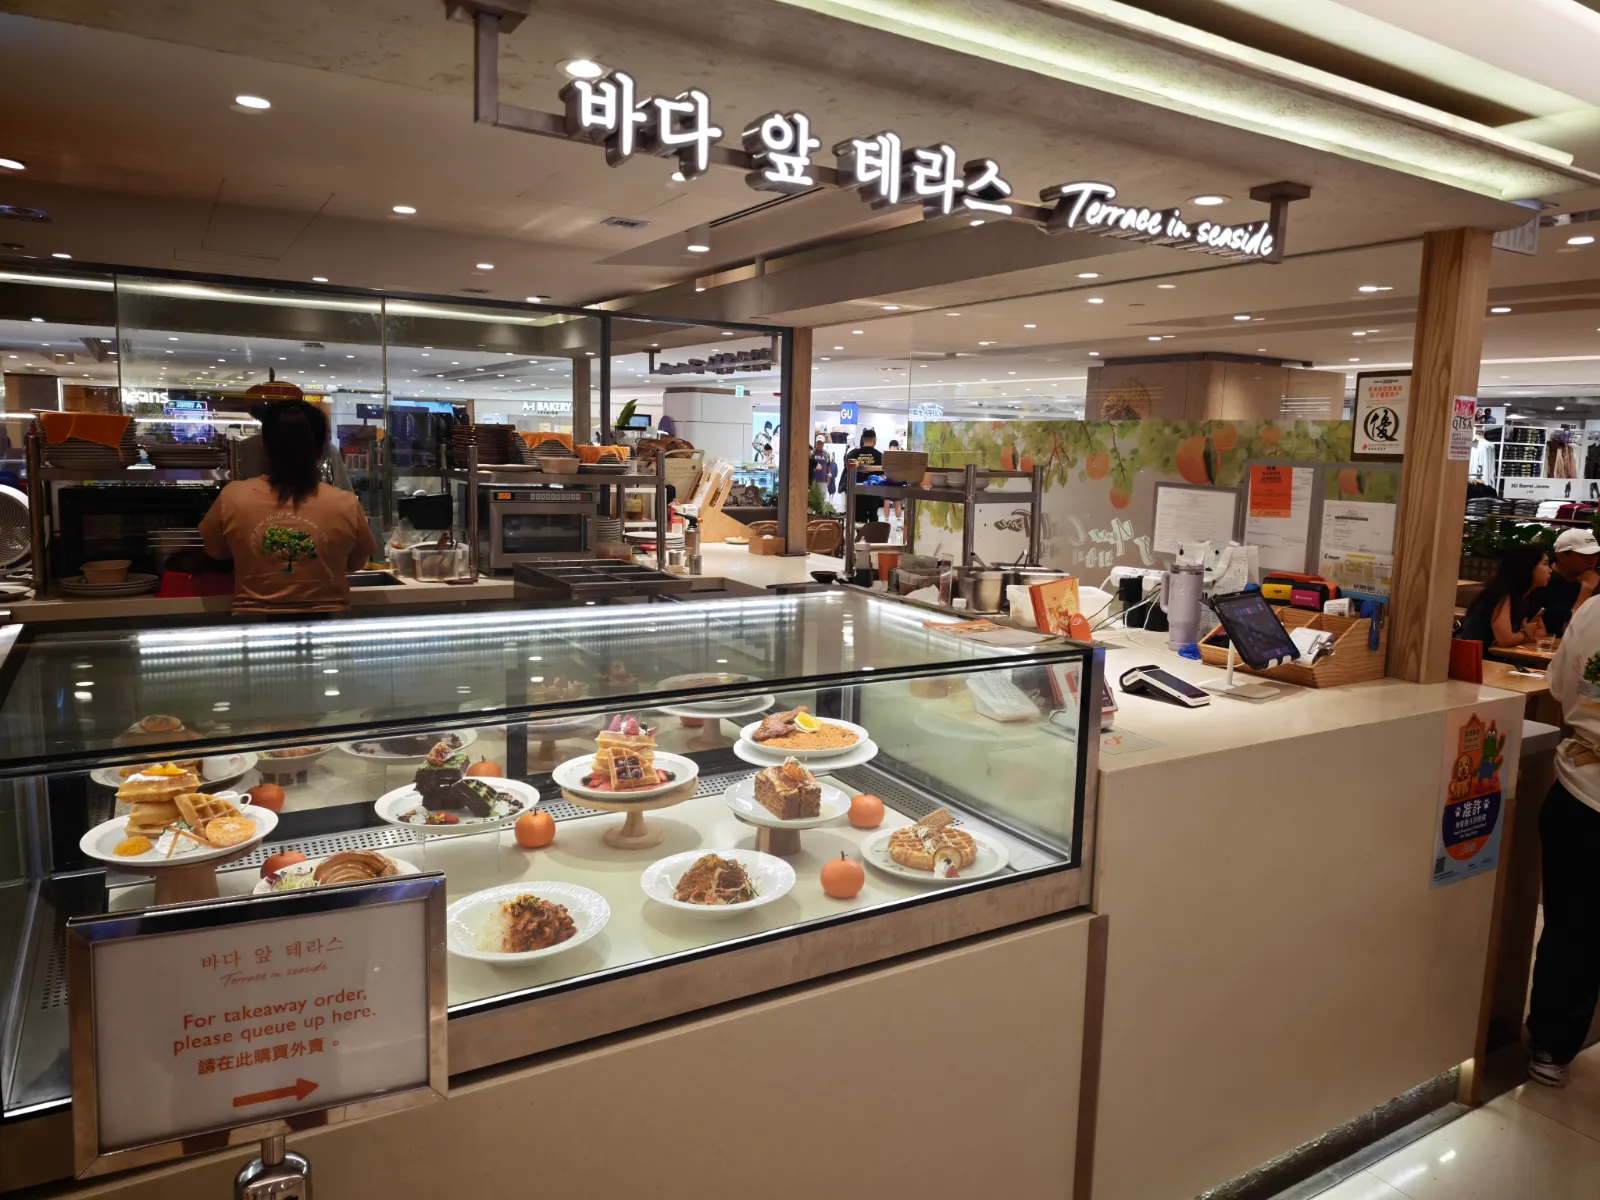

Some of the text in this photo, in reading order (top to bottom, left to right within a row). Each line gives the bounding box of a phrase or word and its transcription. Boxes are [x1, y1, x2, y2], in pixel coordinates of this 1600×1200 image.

[576, 71, 1013, 214] 바다 앞 테라스
[1061, 182, 1274, 257] Terrace in seaside
[536, 402, 572, 413] BAKERY
[840, 409, 853, 420] GU
[1452, 416, 1473, 431] QTSA
[1370, 409, 1399, 442] 優
[201, 936, 345, 971] 바다 앞 테라스
[183, 988, 368, 1031] For takeaway order,
[173, 1006, 376, 1057] please queue up here.
